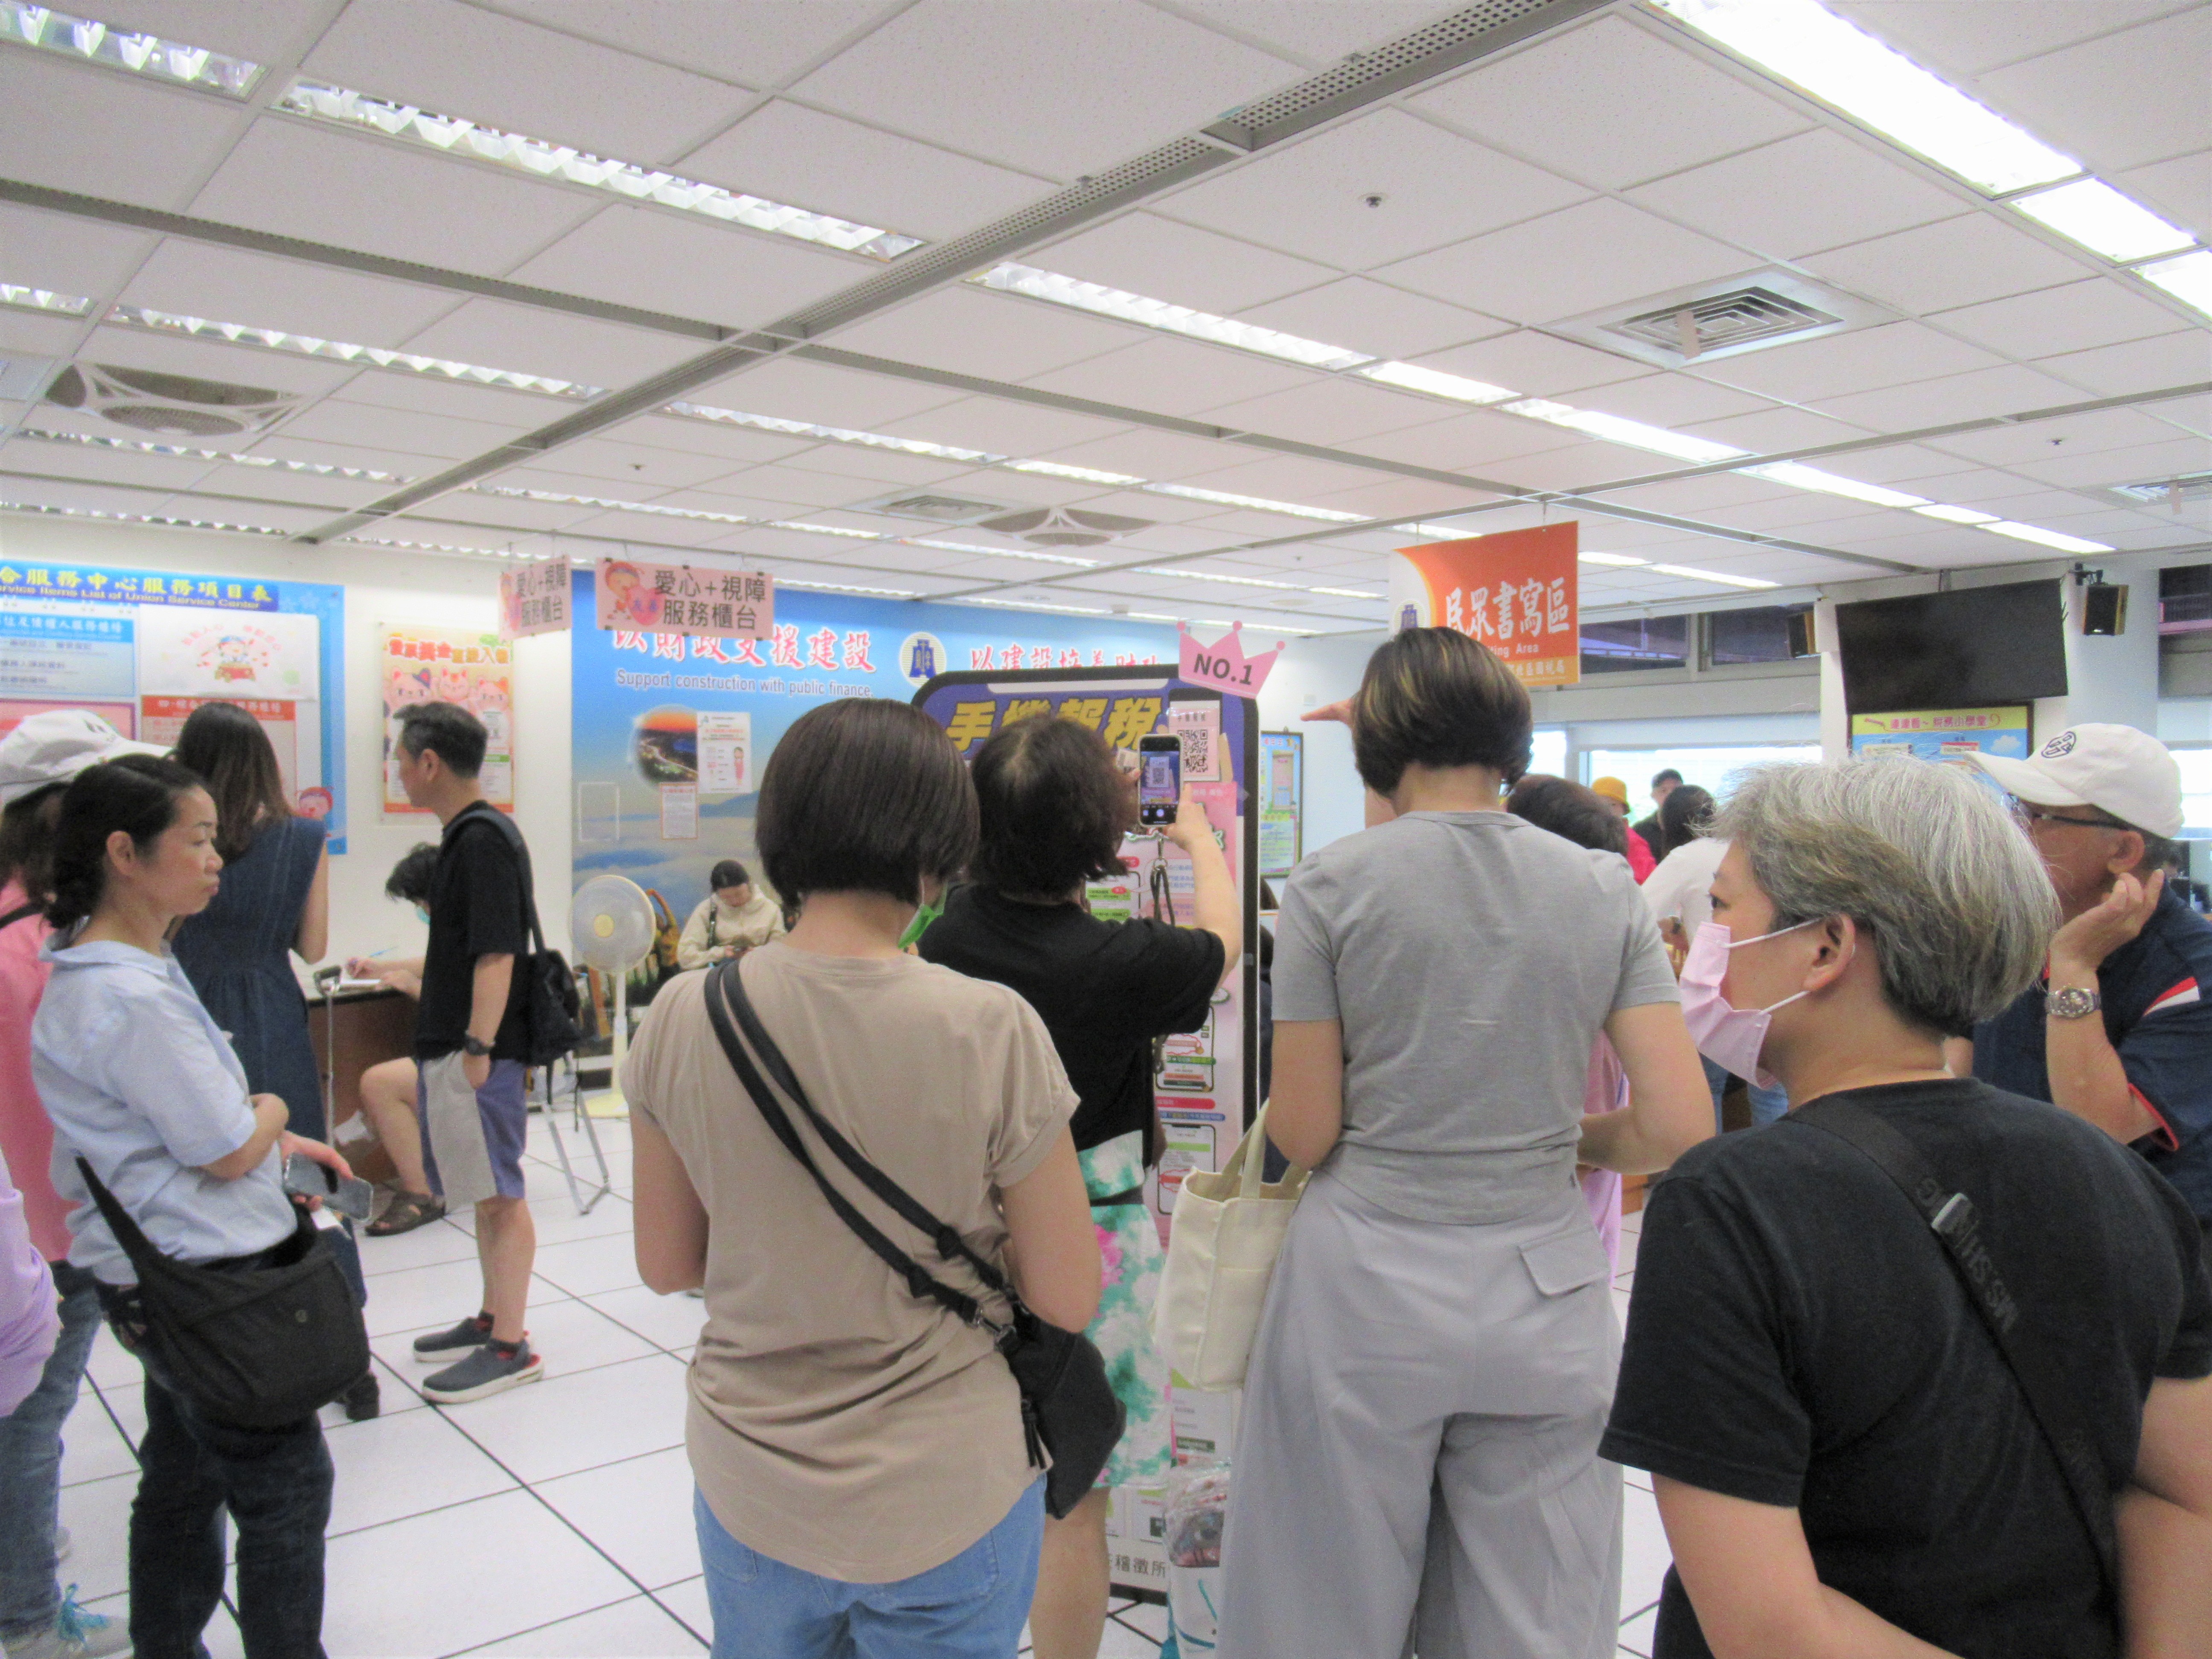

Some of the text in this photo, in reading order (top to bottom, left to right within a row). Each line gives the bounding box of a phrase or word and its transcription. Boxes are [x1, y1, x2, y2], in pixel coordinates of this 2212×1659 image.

[655, 569, 766, 603] 愛心+視障
[663, 601, 757, 631] 服務櫃台
[1446, 577, 1570, 641] 民眾書寫區
[1516, 643, 1539, 654] Area
[617, 669, 874, 698] Support construction with public finance.
[1193, 653, 1252, 686] NO.1
